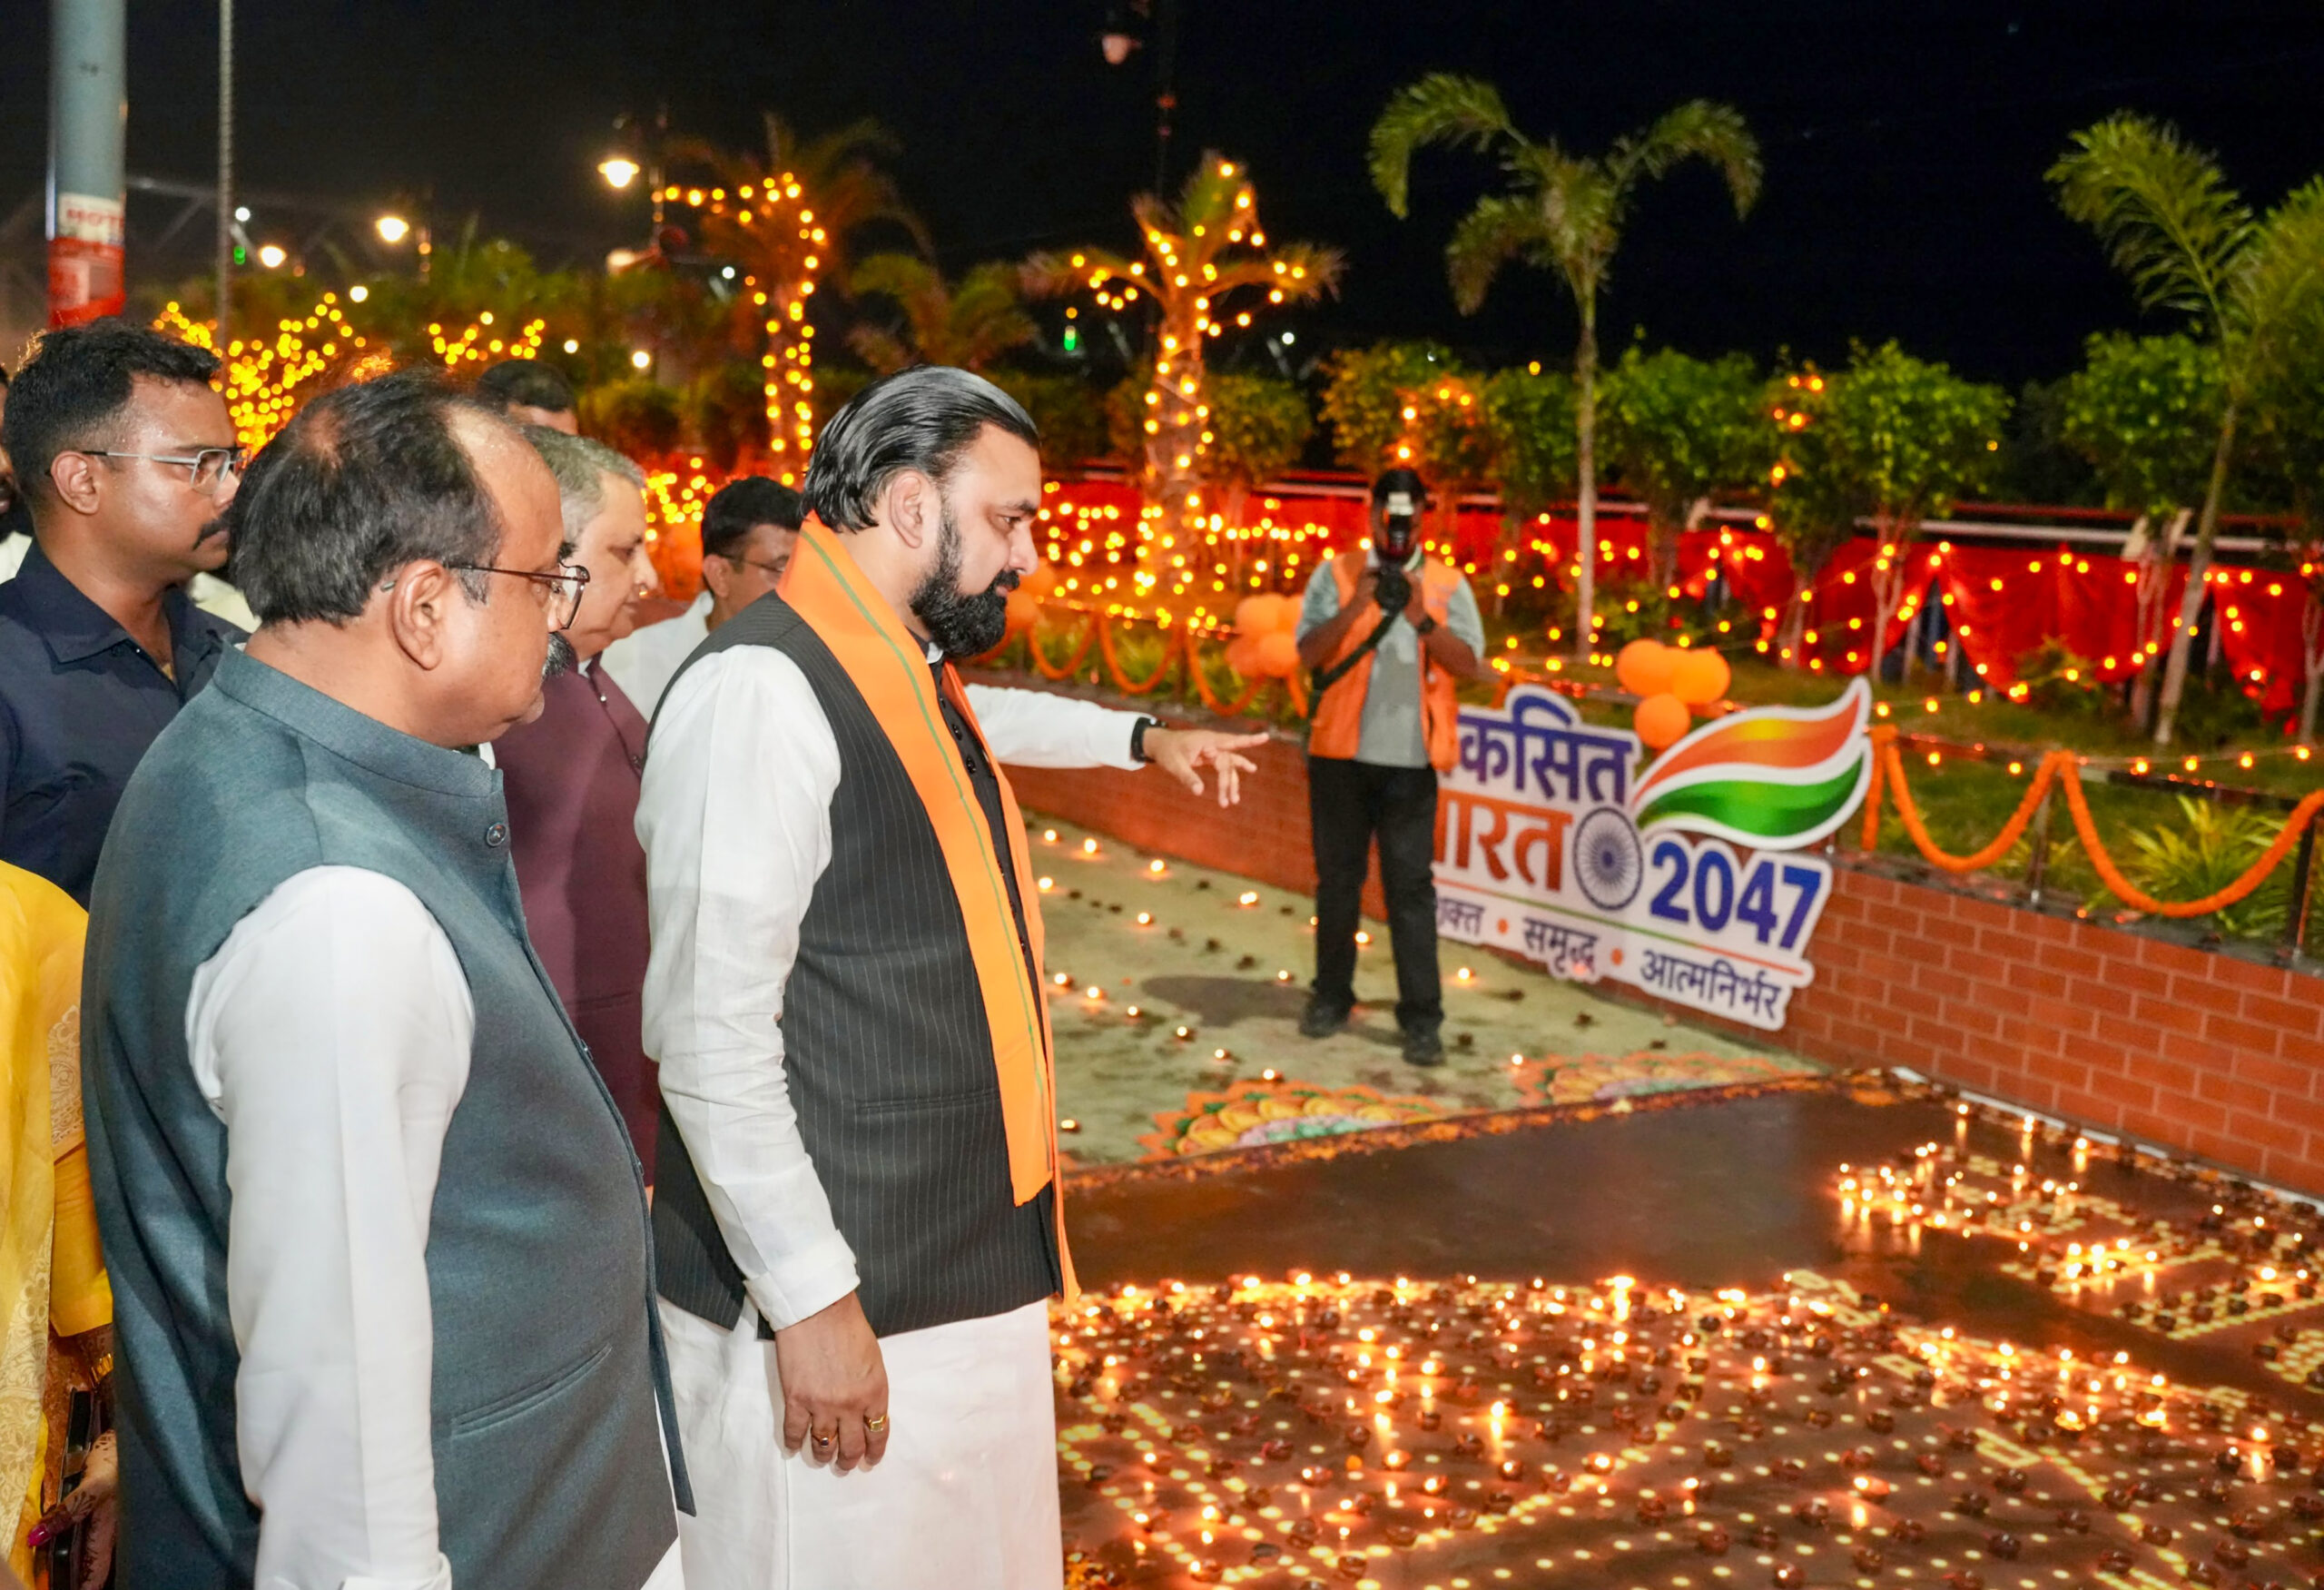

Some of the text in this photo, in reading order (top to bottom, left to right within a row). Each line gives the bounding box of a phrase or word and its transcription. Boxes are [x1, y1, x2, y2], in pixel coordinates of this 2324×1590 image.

[1456, 695, 1633, 806] कसित
[1649, 841, 1822, 951] 2047
[1640, 948, 1782, 1020] आत्मनिर्भर
